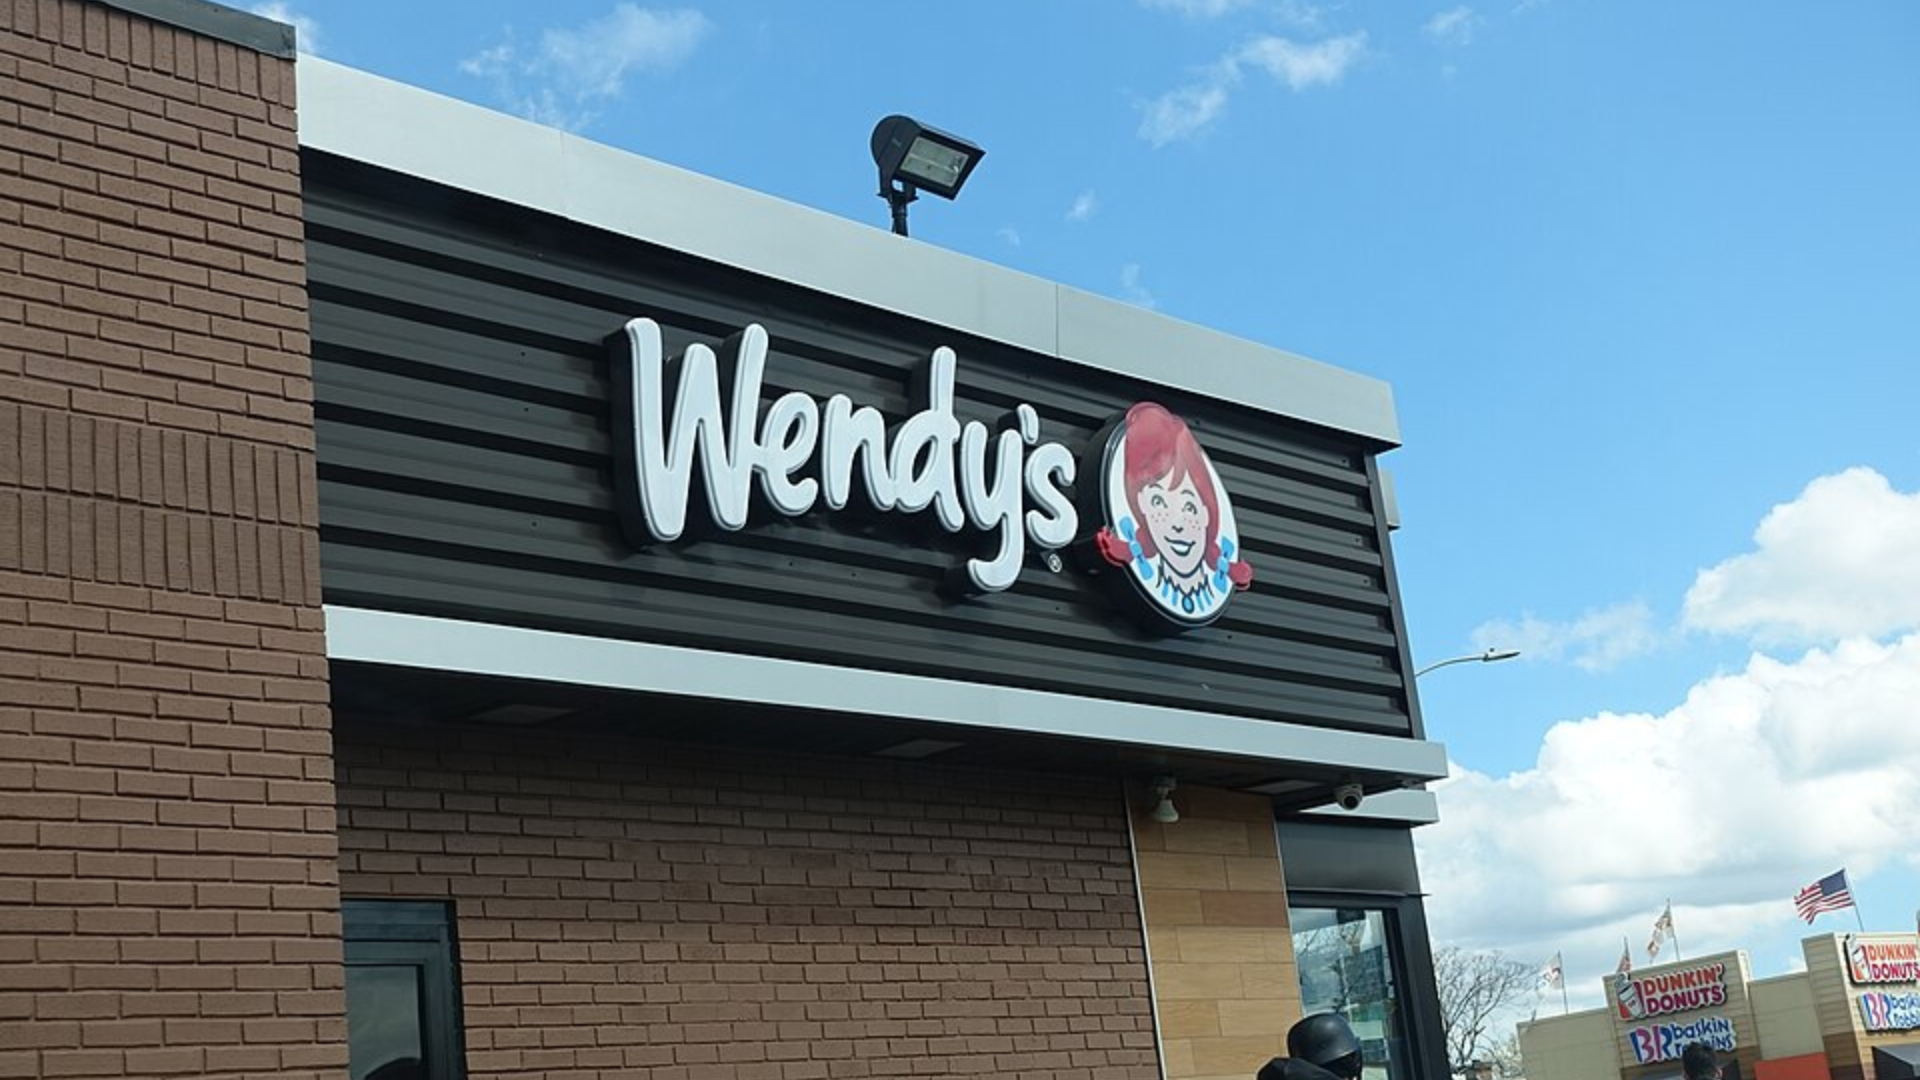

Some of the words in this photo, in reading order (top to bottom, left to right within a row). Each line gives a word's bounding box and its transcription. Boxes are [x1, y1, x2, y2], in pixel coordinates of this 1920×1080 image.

[626, 317, 1078, 591] Wendy's
[1643, 963, 1723, 997] DUNKIN'
[1645, 984, 1723, 1014] DONUTS
[1629, 1025, 1673, 1063] BR
